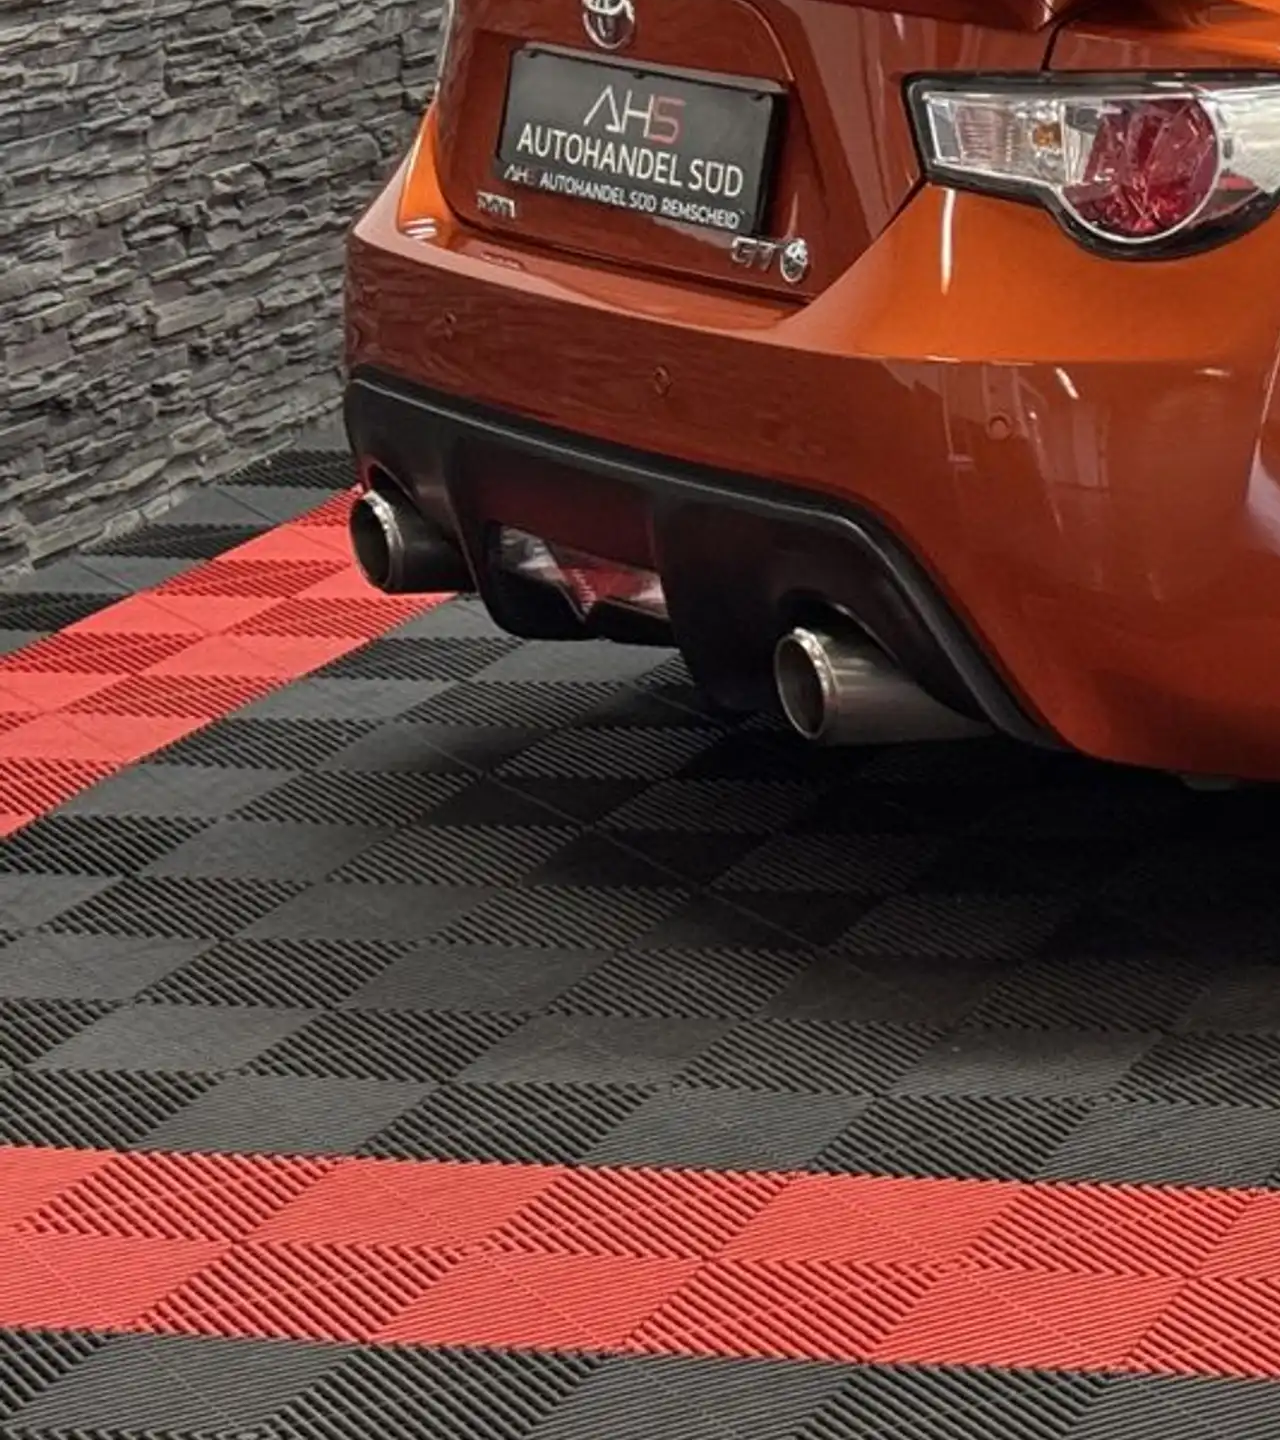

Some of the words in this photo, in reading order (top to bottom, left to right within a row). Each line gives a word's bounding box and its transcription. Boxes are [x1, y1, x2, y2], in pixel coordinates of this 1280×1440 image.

[583, 84, 686, 144] AHS
[516, 122, 683, 188] AUTOHANDEL
[688, 159, 744, 197] SÜD
[539, 171, 626, 207] AUTOHANDEL
[659, 197, 740, 230] REMSCHEID
